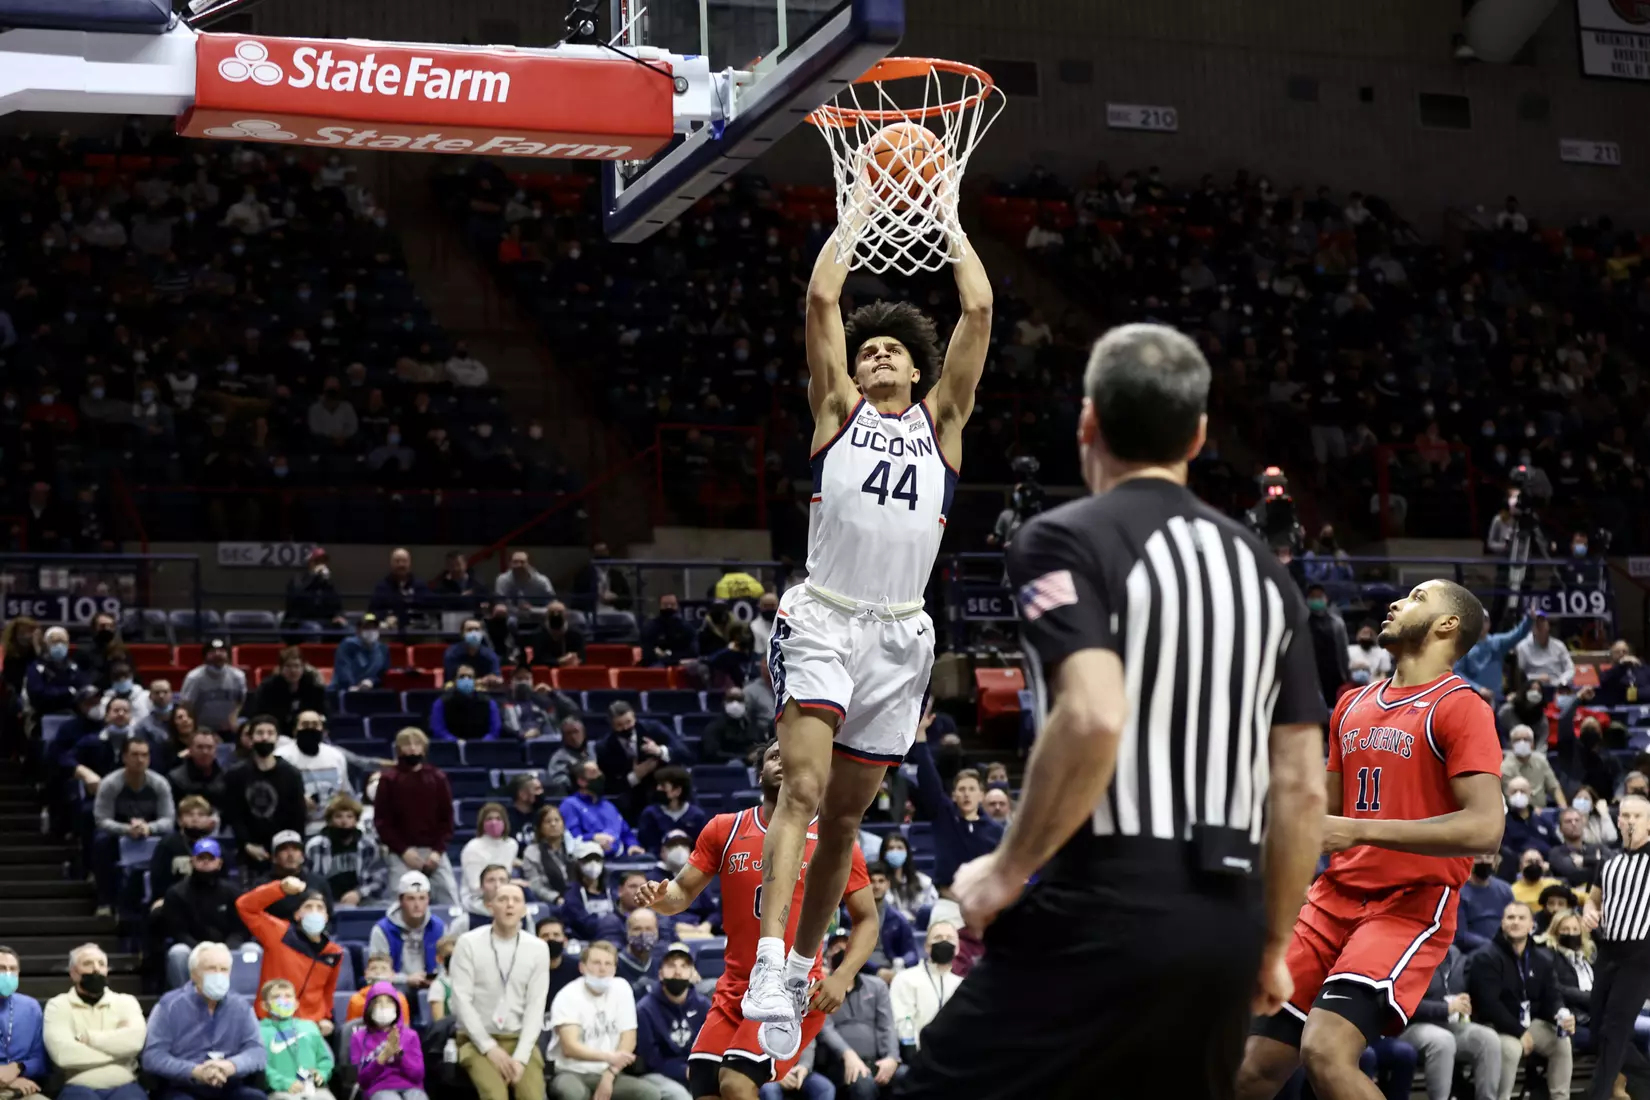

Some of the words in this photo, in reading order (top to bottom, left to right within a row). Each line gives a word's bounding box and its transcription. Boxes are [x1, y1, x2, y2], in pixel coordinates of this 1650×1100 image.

[1139, 109, 1176, 127] 210
[850, 427, 933, 458] UCONN
[861, 460, 919, 511] 44
[7, 599, 48, 616] SEC
[967, 597, 1003, 613] SEC
[1556, 590, 1606, 616] 109
[1359, 726, 1415, 759] JOHN'S
[1355, 767, 1382, 811] 11
[728, 851, 750, 874] ST.
